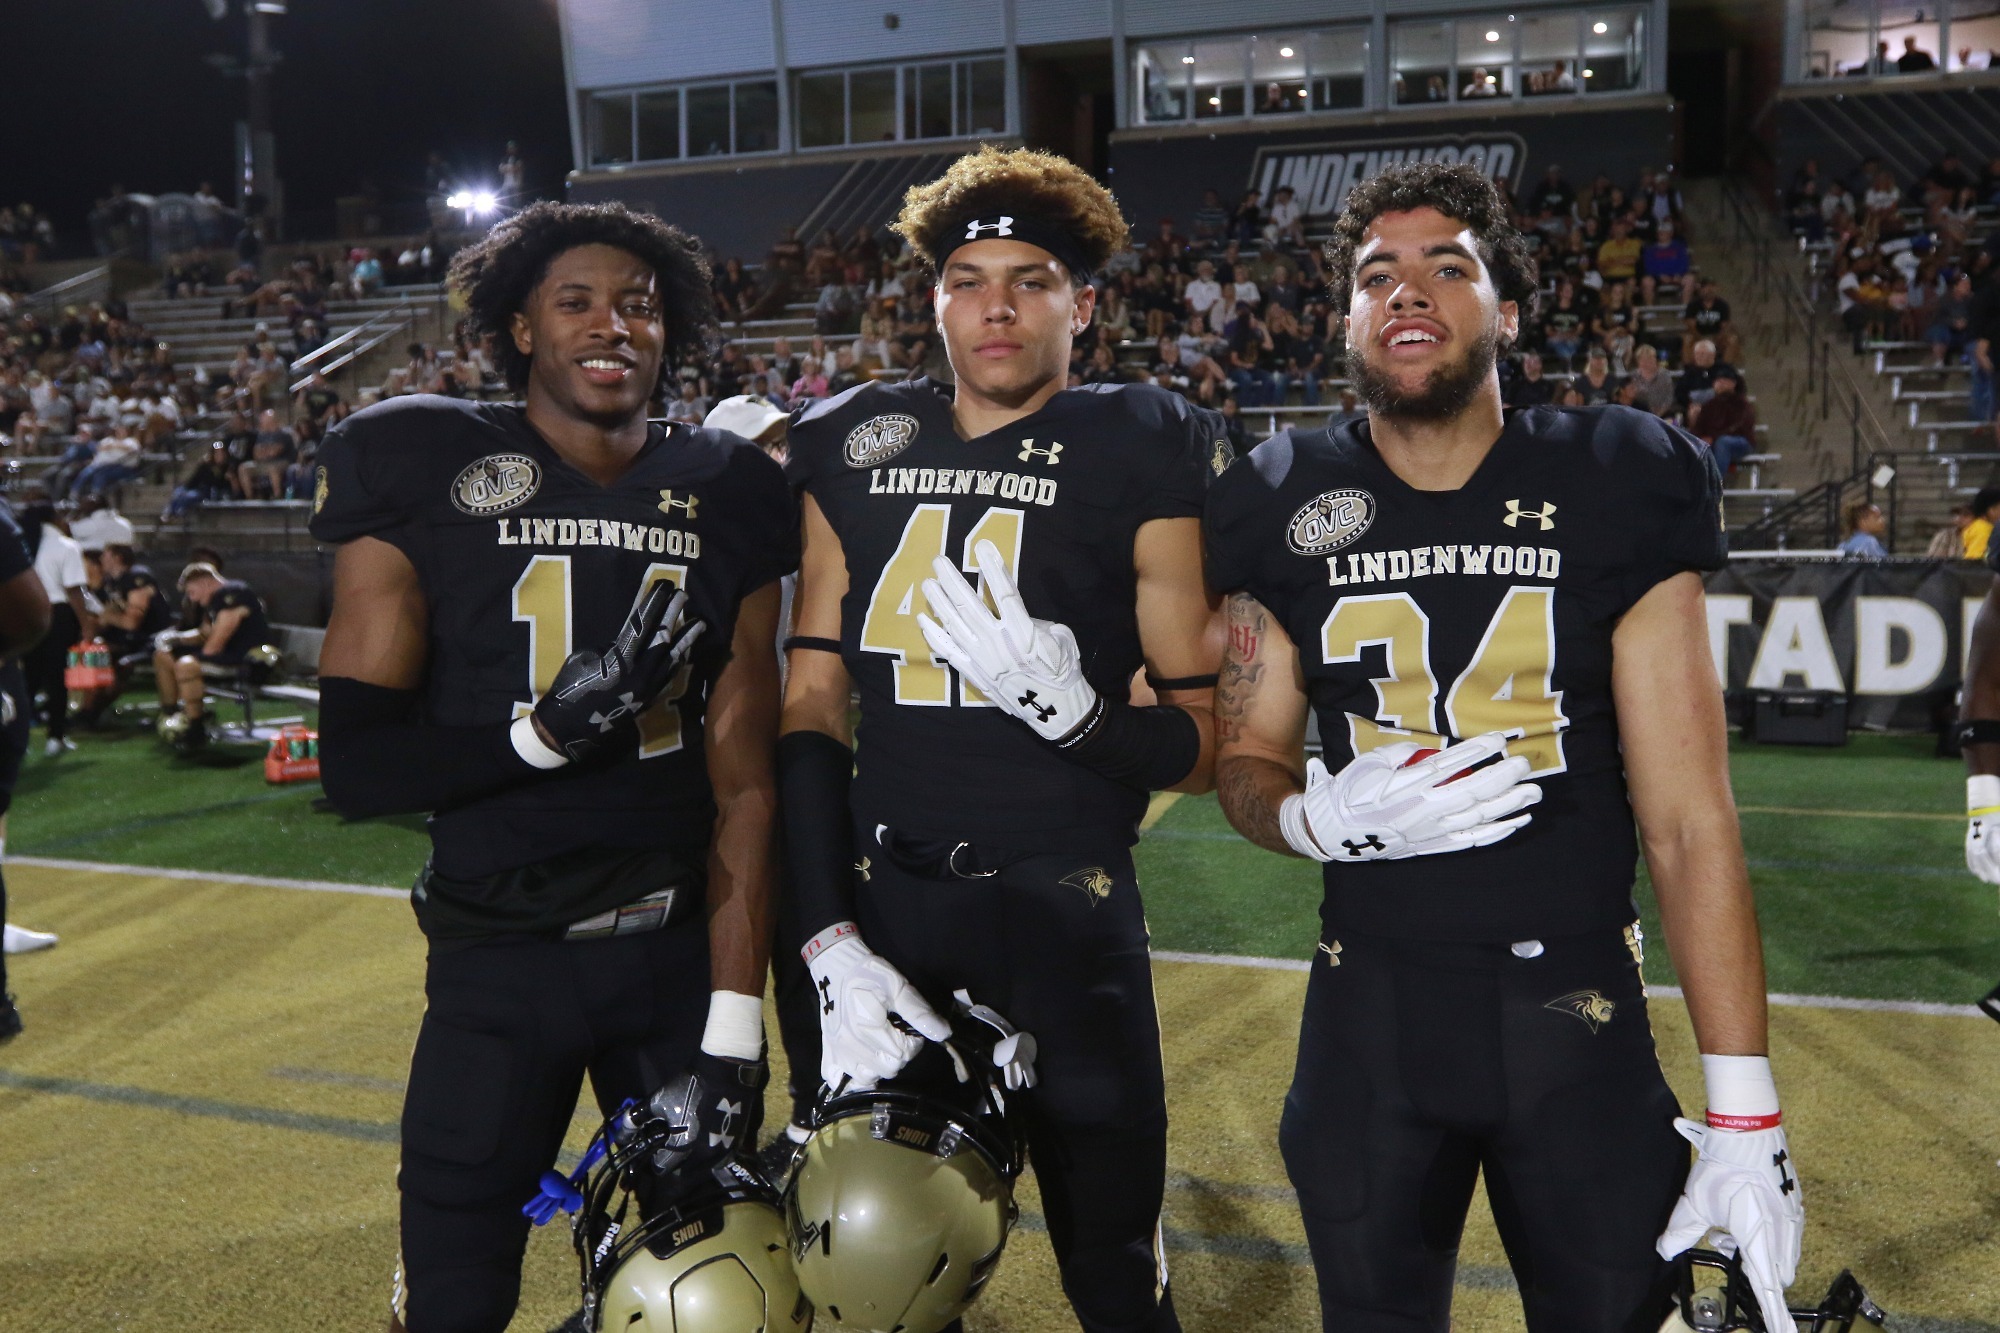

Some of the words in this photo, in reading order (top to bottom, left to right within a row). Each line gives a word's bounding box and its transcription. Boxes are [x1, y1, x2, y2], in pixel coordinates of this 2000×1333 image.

[857, 423, 901, 457] OVC
[470, 466, 523, 504] OVC
[869, 468, 1058, 506] LINDENWOOD
[498, 518, 700, 560] LINDENWOOD
[1304, 501, 1357, 543] OVC
[1326, 545, 1561, 586] LINDENWOOD
[860, 503, 1025, 707] 41
[1321, 585, 1569, 780] 34
[894, 1126, 931, 1147] LIONS
[1725, 1119, 1750, 1127] ALPHA
[672, 1220, 705, 1247] LIONS
